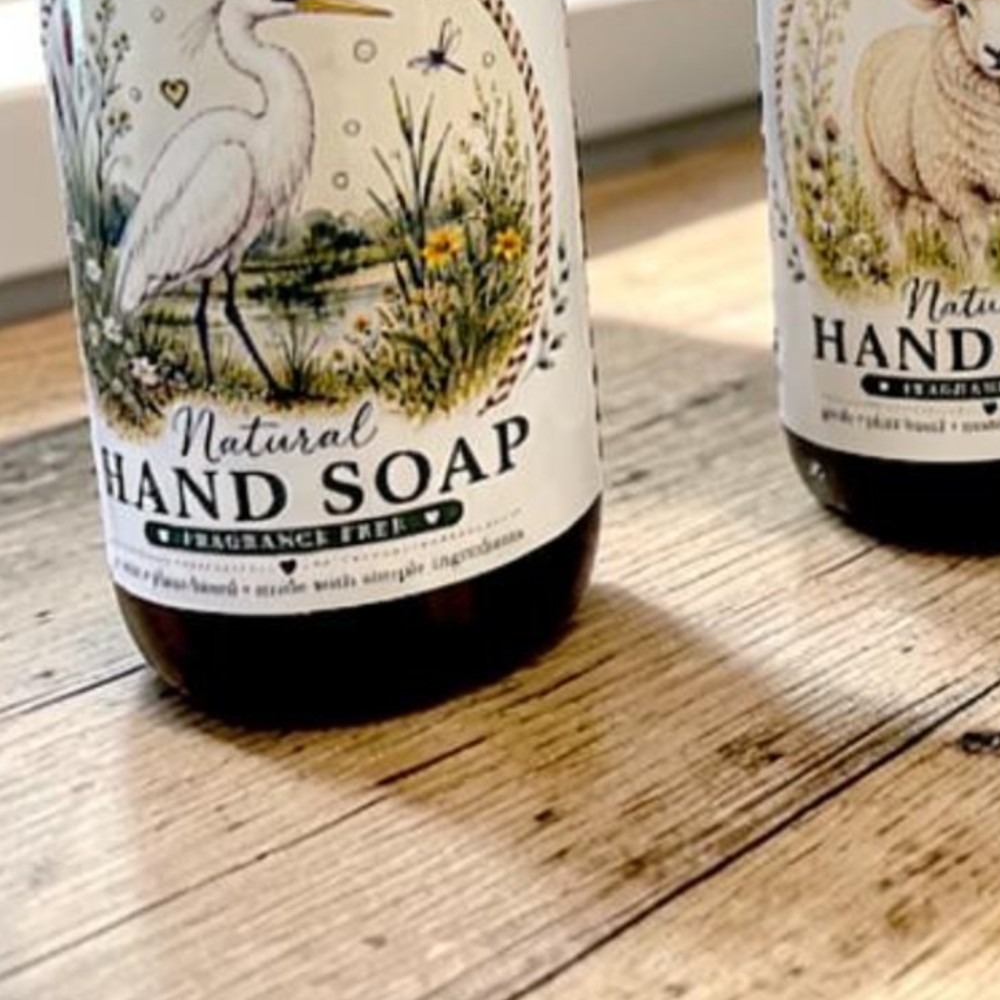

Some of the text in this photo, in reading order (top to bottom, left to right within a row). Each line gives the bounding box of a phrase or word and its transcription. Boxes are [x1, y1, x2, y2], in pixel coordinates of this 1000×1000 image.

[812, 314, 994, 372] HAND
[172, 400, 378, 463] Natural
[101, 414, 531, 523] HAND SOAP
[182, 516, 407, 551] FRAGRANCE FREE
